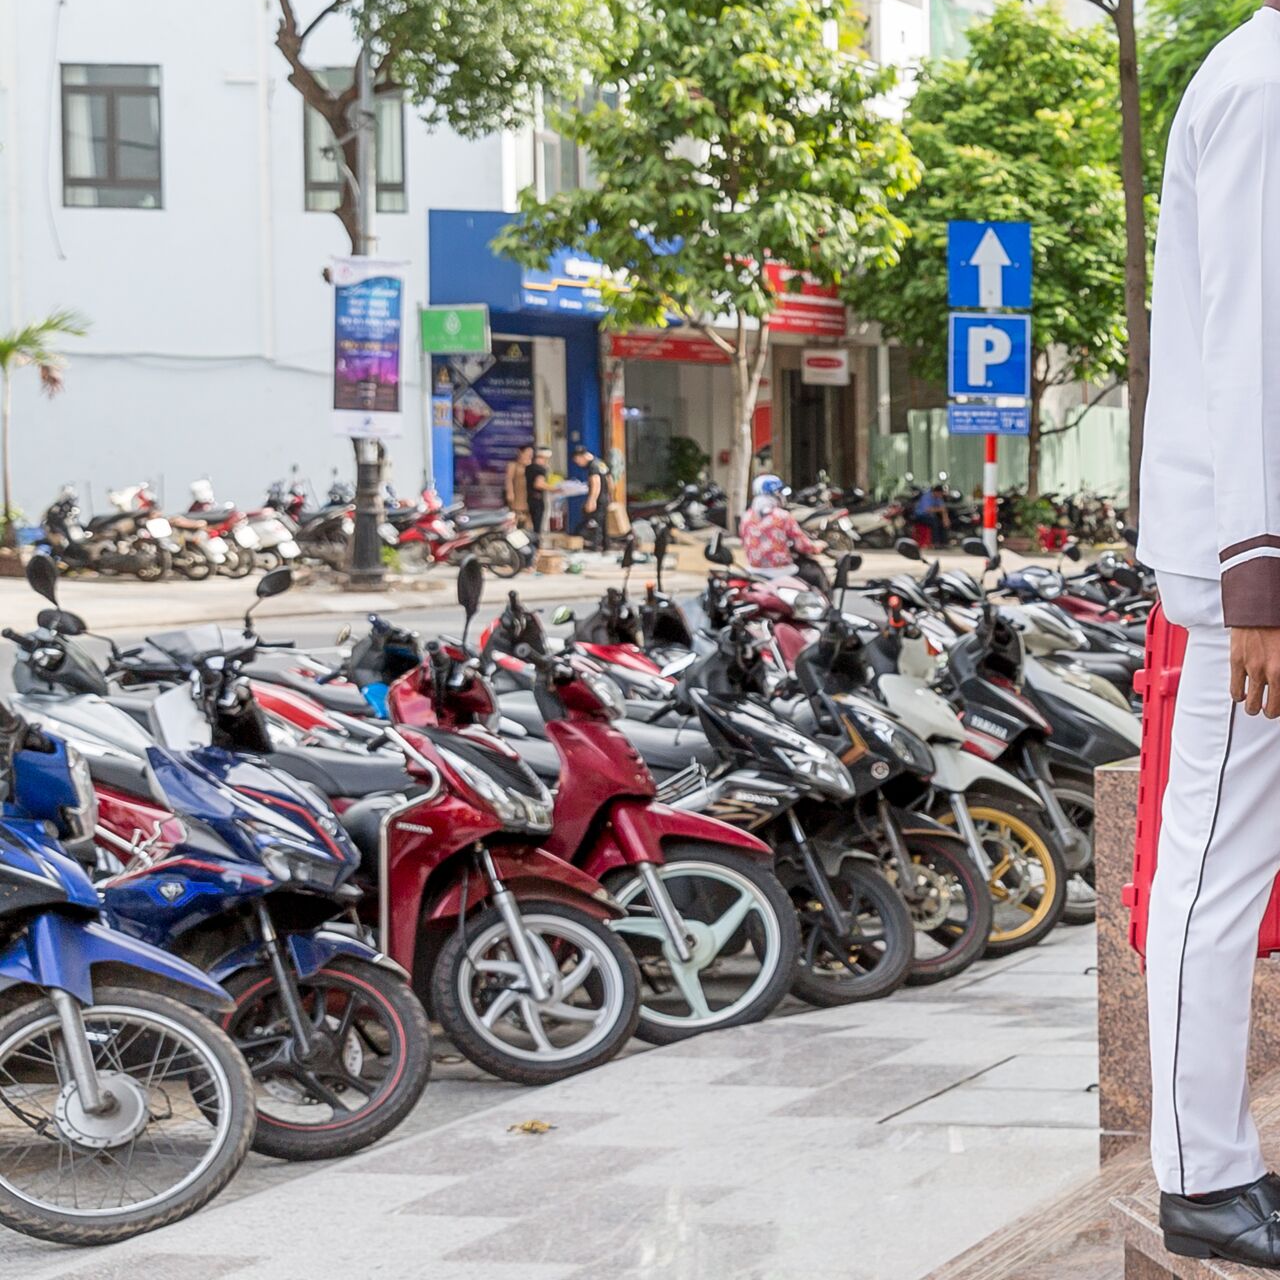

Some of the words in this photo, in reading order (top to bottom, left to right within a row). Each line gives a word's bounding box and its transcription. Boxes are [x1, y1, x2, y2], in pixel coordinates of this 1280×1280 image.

[967, 325, 1012, 387] P
[971, 714, 1008, 740] YAMAHA
[736, 791, 779, 806] HONDA
[395, 821, 433, 835] HONDA
